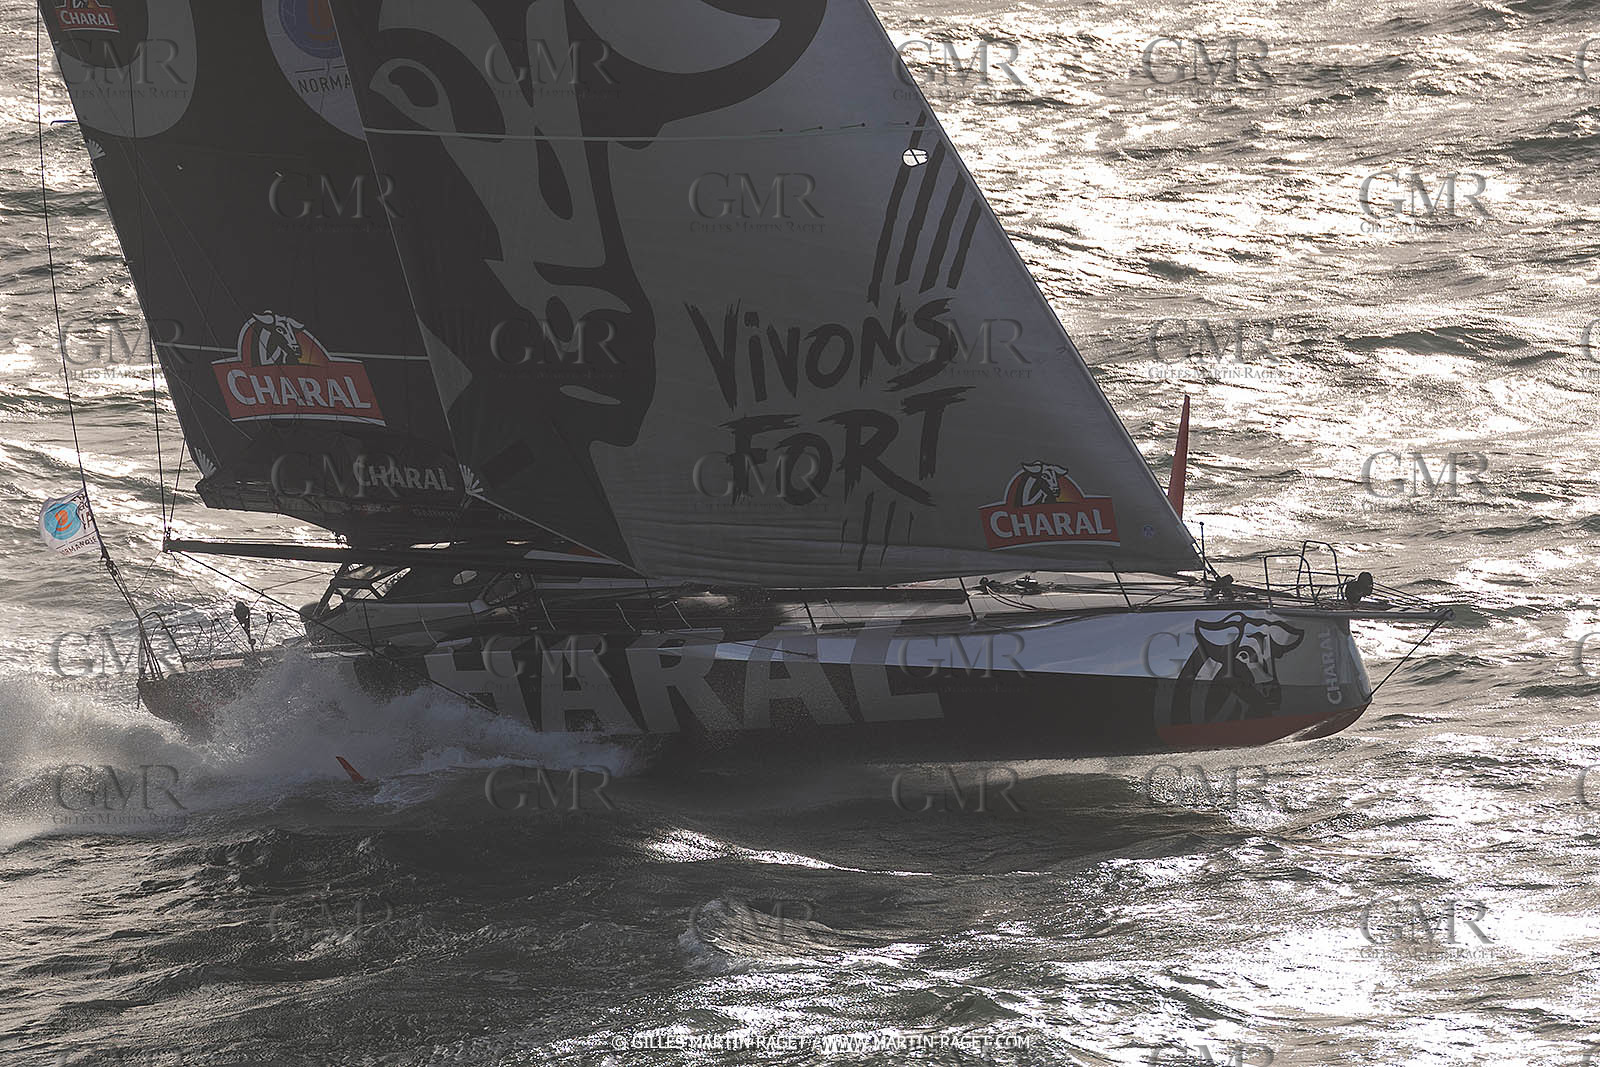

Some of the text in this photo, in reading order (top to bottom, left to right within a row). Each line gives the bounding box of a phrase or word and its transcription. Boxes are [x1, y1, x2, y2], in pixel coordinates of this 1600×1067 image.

[59, 9, 115, 26] CHARAL
[226, 369, 373, 409] CHARAL
[713, 386, 976, 507] FORT
[353, 463, 456, 491] CHARAL
[990, 508, 1113, 539] CHARAL
[405, 608, 945, 737] HARAL
[1319, 626, 1343, 705] CHARAL
